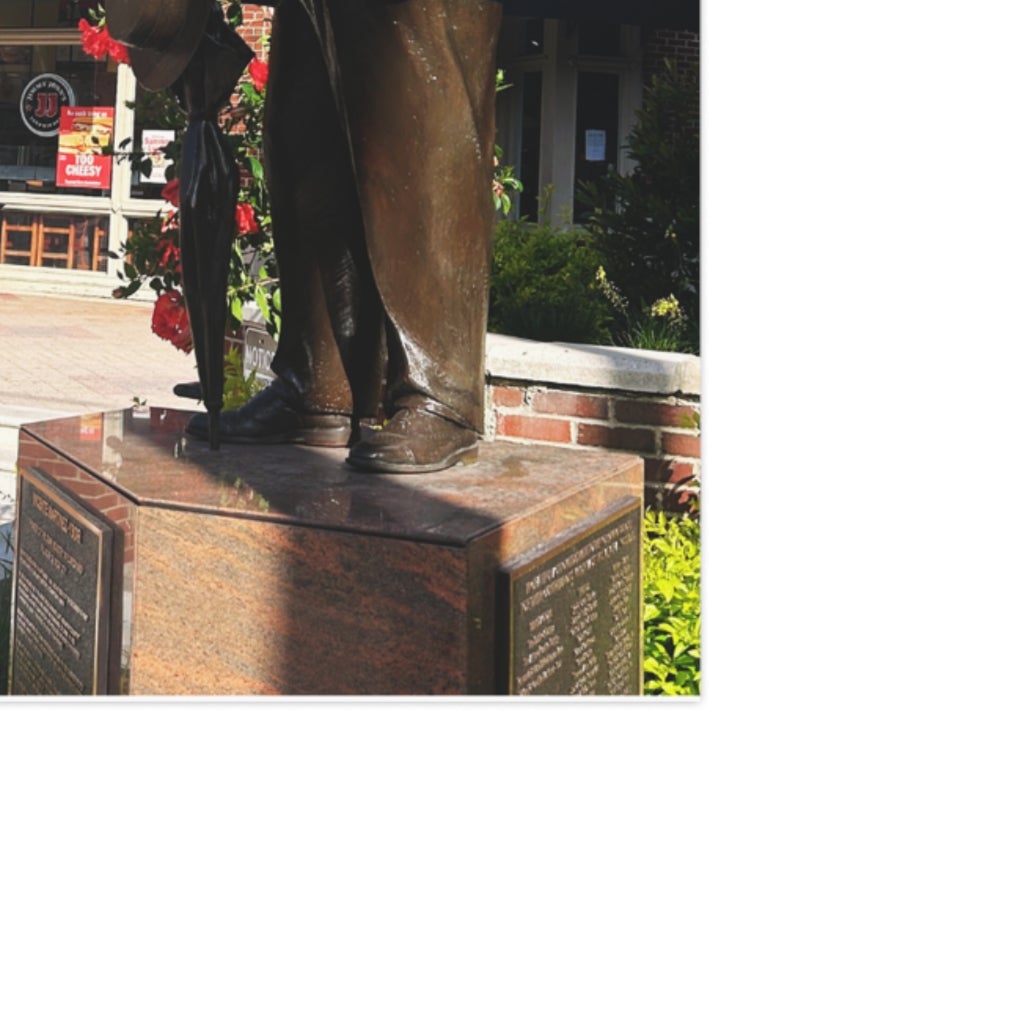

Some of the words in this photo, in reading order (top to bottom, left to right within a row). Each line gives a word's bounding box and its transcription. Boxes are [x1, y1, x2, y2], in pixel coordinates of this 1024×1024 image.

[35, 92, 58, 117] JJ
[74, 153, 95, 165] TOO
[65, 164, 103, 177] CHEESY
[245, 345, 275, 370] NOTIC
